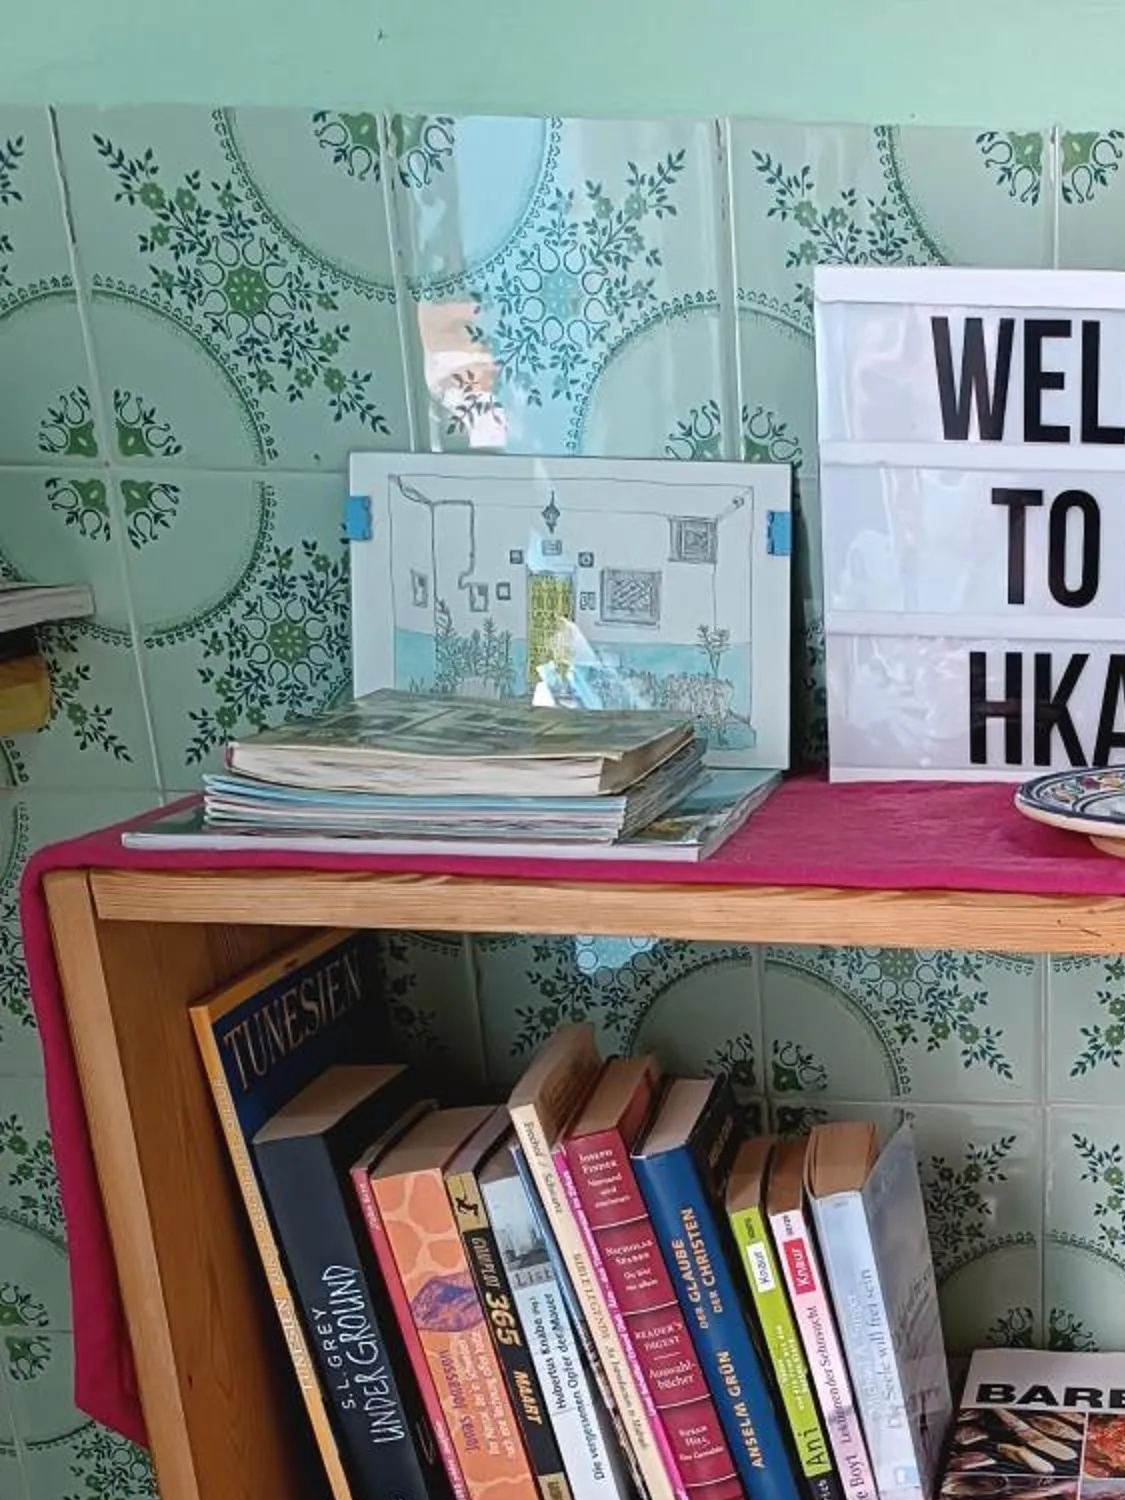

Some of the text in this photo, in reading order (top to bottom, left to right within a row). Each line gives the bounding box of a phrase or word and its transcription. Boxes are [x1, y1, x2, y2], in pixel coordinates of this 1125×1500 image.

[991, 487, 1101, 608] TO
[224, 952, 362, 1091] TUNESIEN
[670, 1237, 702, 1303] GLAUBE
[679, 1205, 716, 1287] CHRISTEN
[750, 1249, 770, 1284] Knaur
[785, 1245, 809, 1287] Knaur
[320, 1257, 384, 1369] GROUND
[854, 1268, 875, 1301] sein
[275, 1295, 315, 1391] TUNESIEN
[310, 1302, 345, 1372] GREY
[484, 1287, 542, 1428] 365 MAART
[531, 1317, 568, 1410] Hubertus Knabe
[867, 1330, 888, 1359] will
[437, 1348, 467, 1410] Jonasson
[559, 1354, 580, 1389] Opfer
[455, 1412, 479, 1452] Jonas
[571, 1387, 603, 1458] vergessenen
[712, 1349, 766, 1471] ANSELM GRÜN
[590, 1459, 607, 1480] Die
[796, 1427, 827, 1469] Ani
[842, 1452, 866, 1487] Boyt
